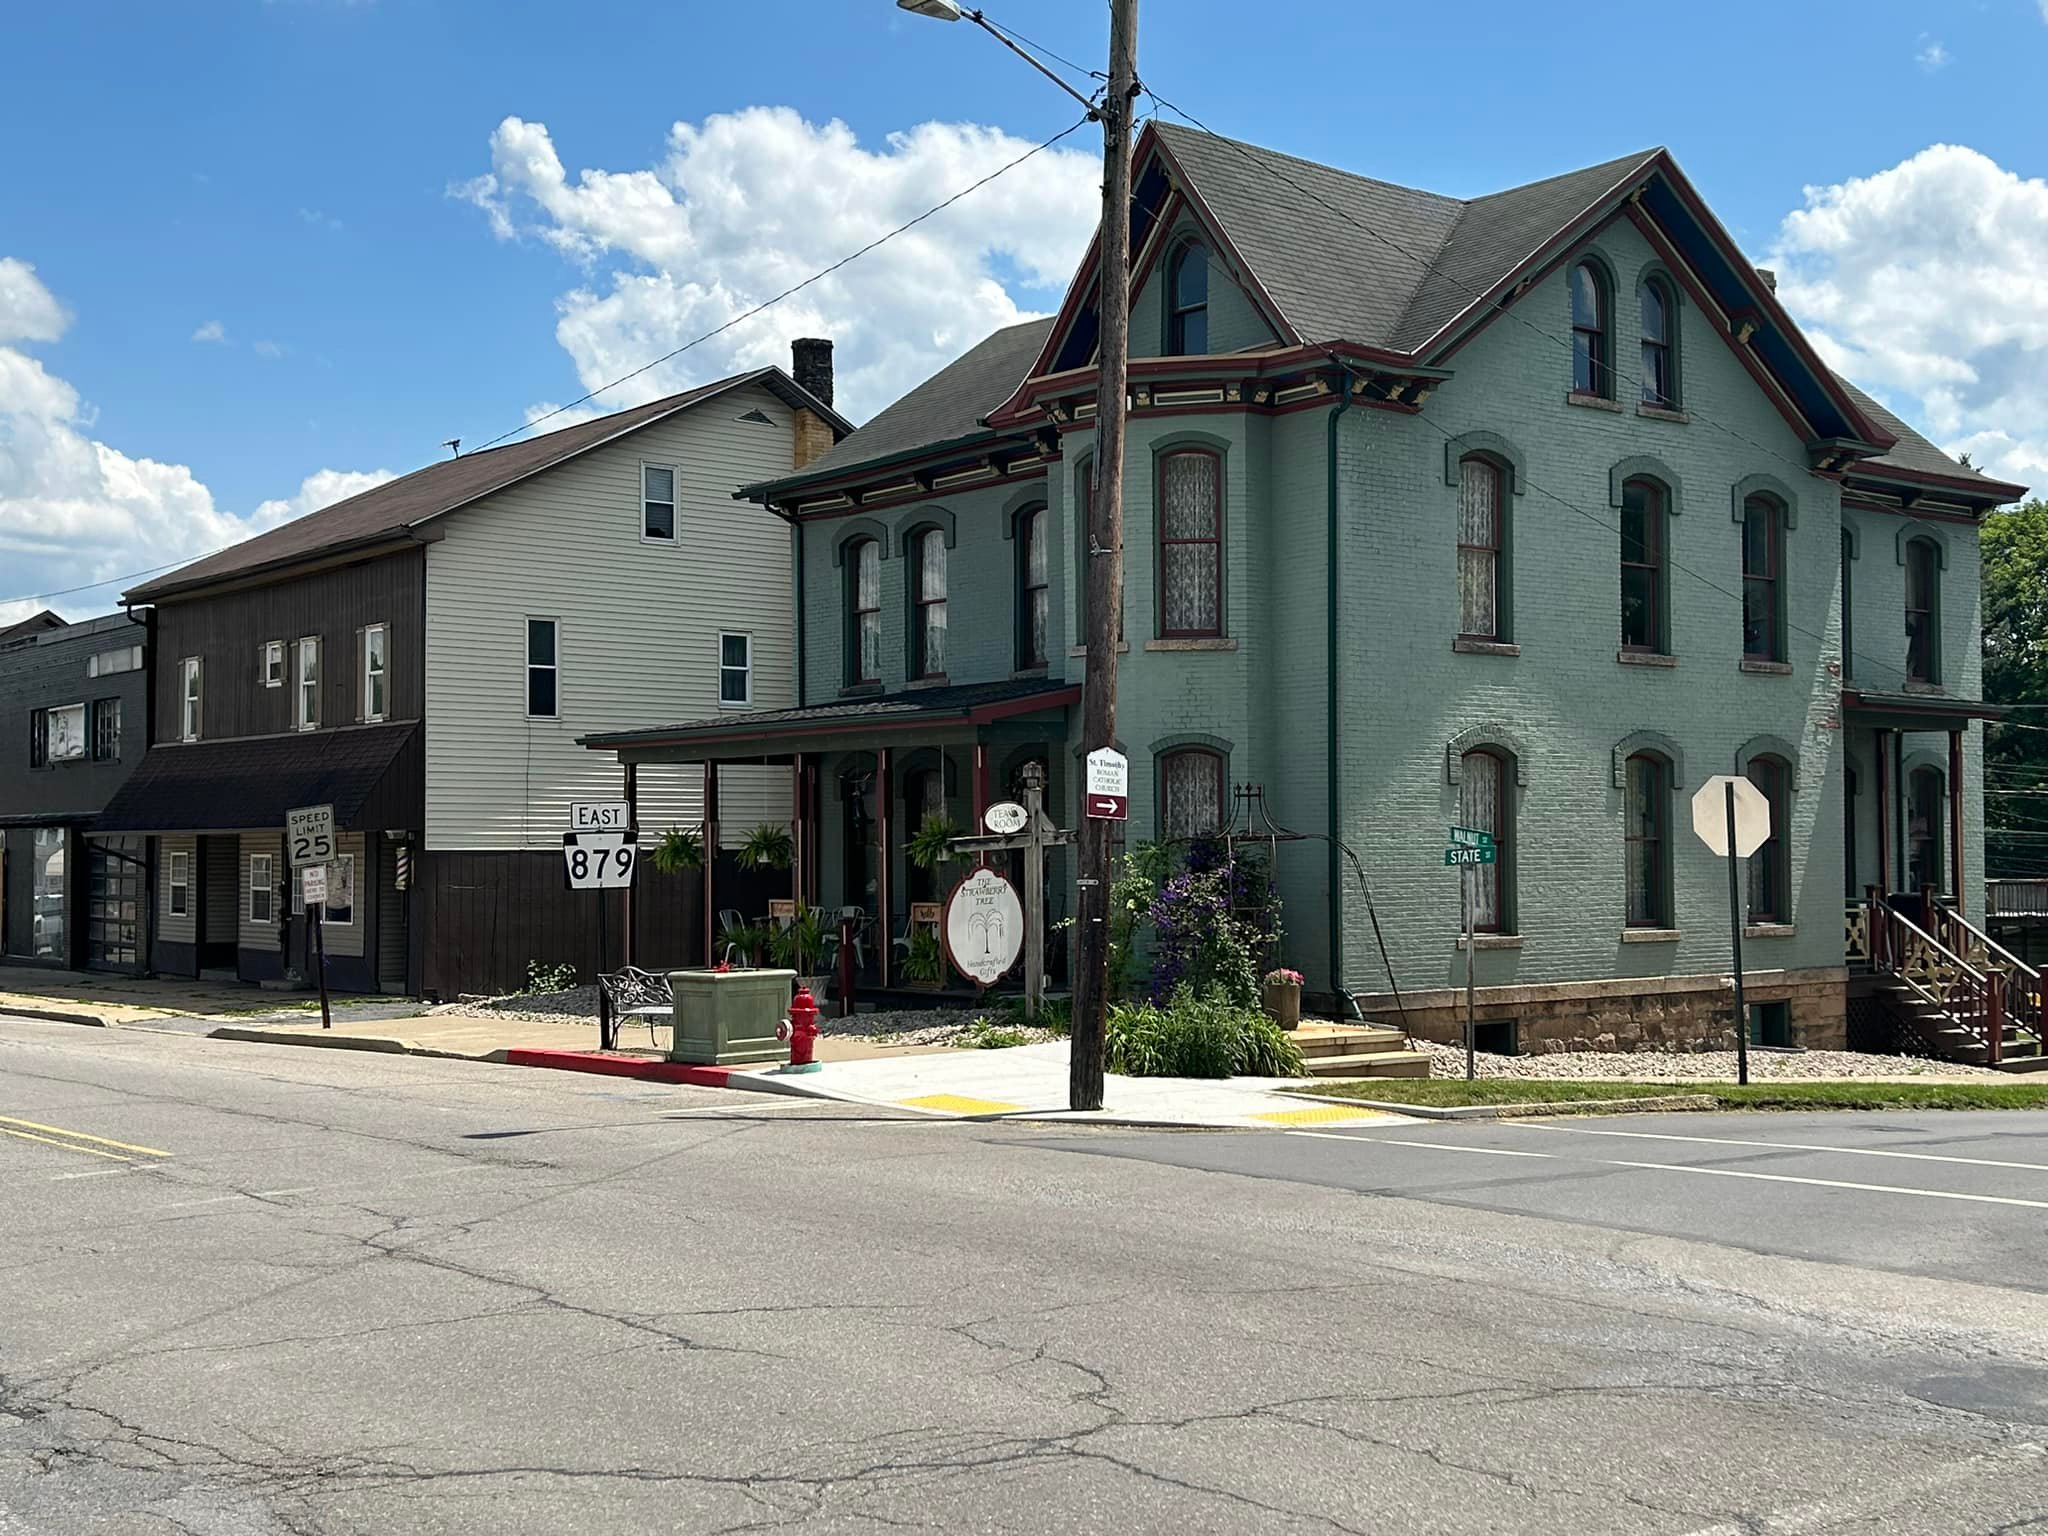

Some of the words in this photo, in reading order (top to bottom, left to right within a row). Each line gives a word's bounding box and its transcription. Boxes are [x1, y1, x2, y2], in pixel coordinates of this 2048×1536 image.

[1092, 776, 1121, 784] CATHOLIC
[1095, 784, 1119, 792] CHURCH
[291, 811, 329, 825] SPEED
[579, 807, 620, 825] EAST
[993, 809, 1009, 818] TEA
[296, 823, 324, 836] LIMIT
[994, 819, 1020, 828] ROOM
[294, 835, 330, 859] 25
[1450, 849, 1481, 864] STATE
[571, 848, 632, 880] 879
[977, 878, 991, 886] THE
[960, 884, 1008, 898] STRAWBERRY
[976, 897, 994, 905] TREE
